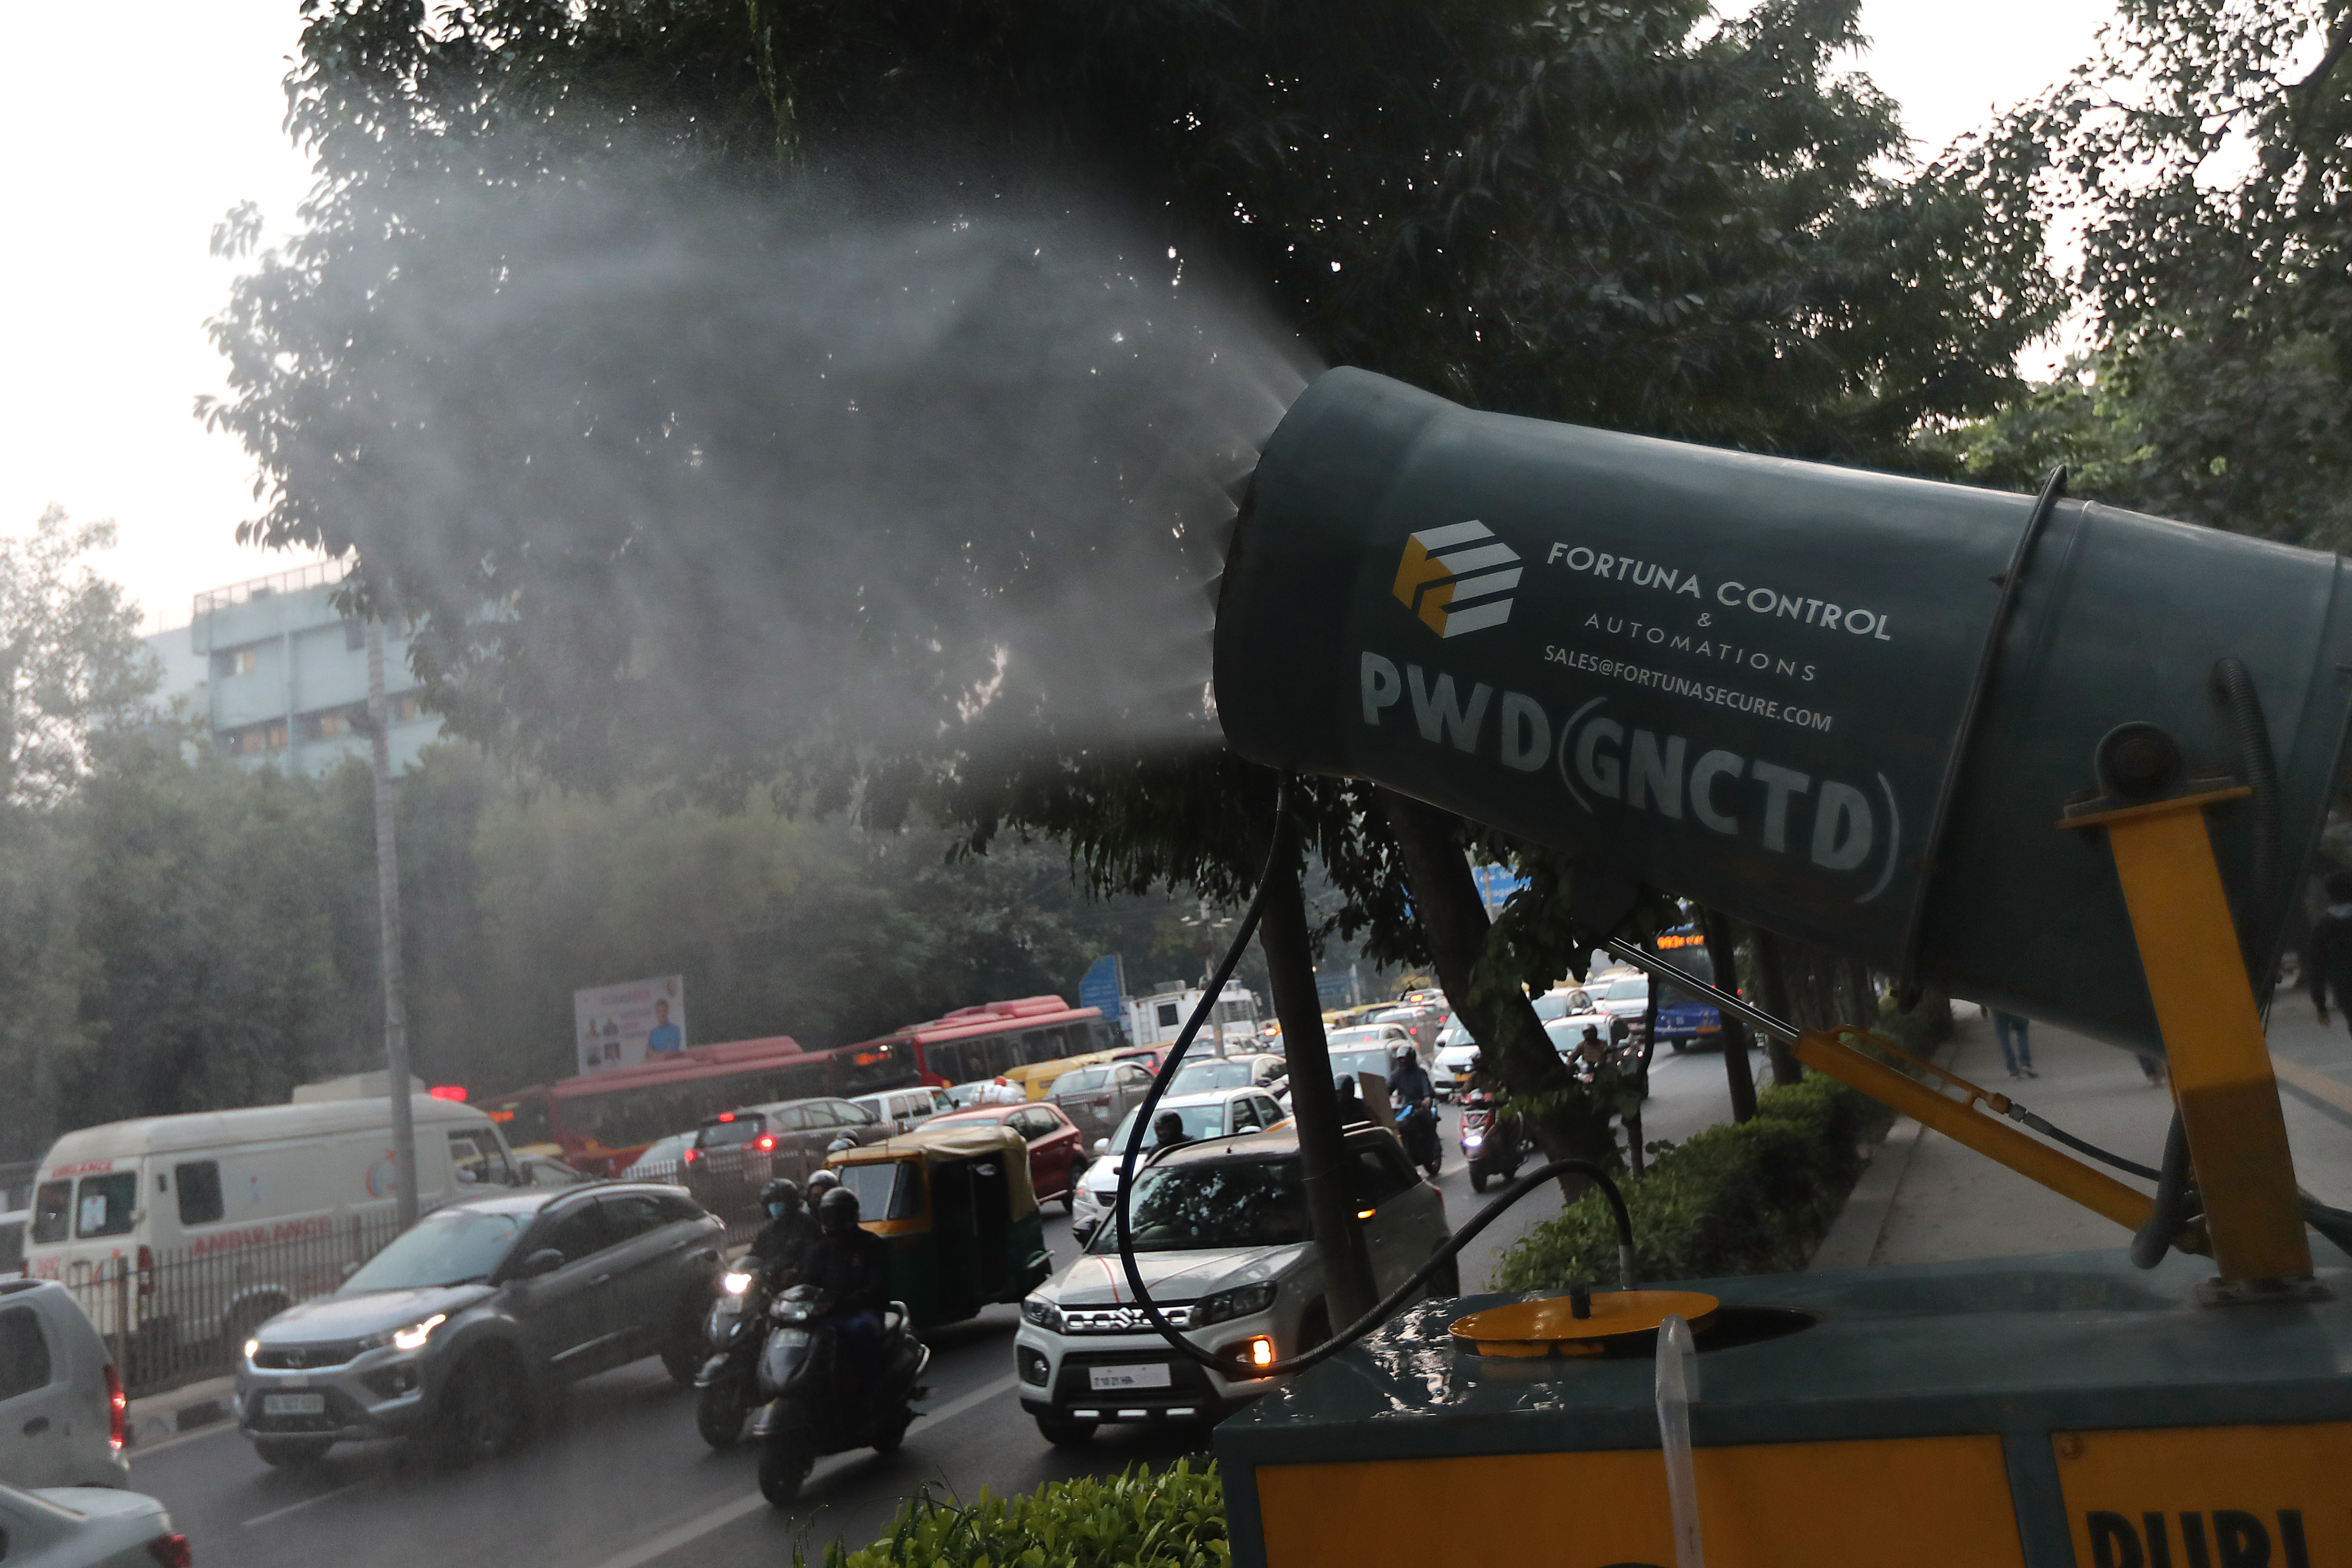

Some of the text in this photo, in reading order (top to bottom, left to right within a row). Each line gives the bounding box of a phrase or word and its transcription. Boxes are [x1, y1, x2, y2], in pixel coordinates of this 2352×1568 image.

[1547, 542, 1891, 641] FORTUNA CONTROL
[1697, 613, 1711, 627] &
[1584, 613, 1816, 681] AUTOMATIONS
[1544, 646, 1832, 732] SALES@FORTUNASECURE.COM
